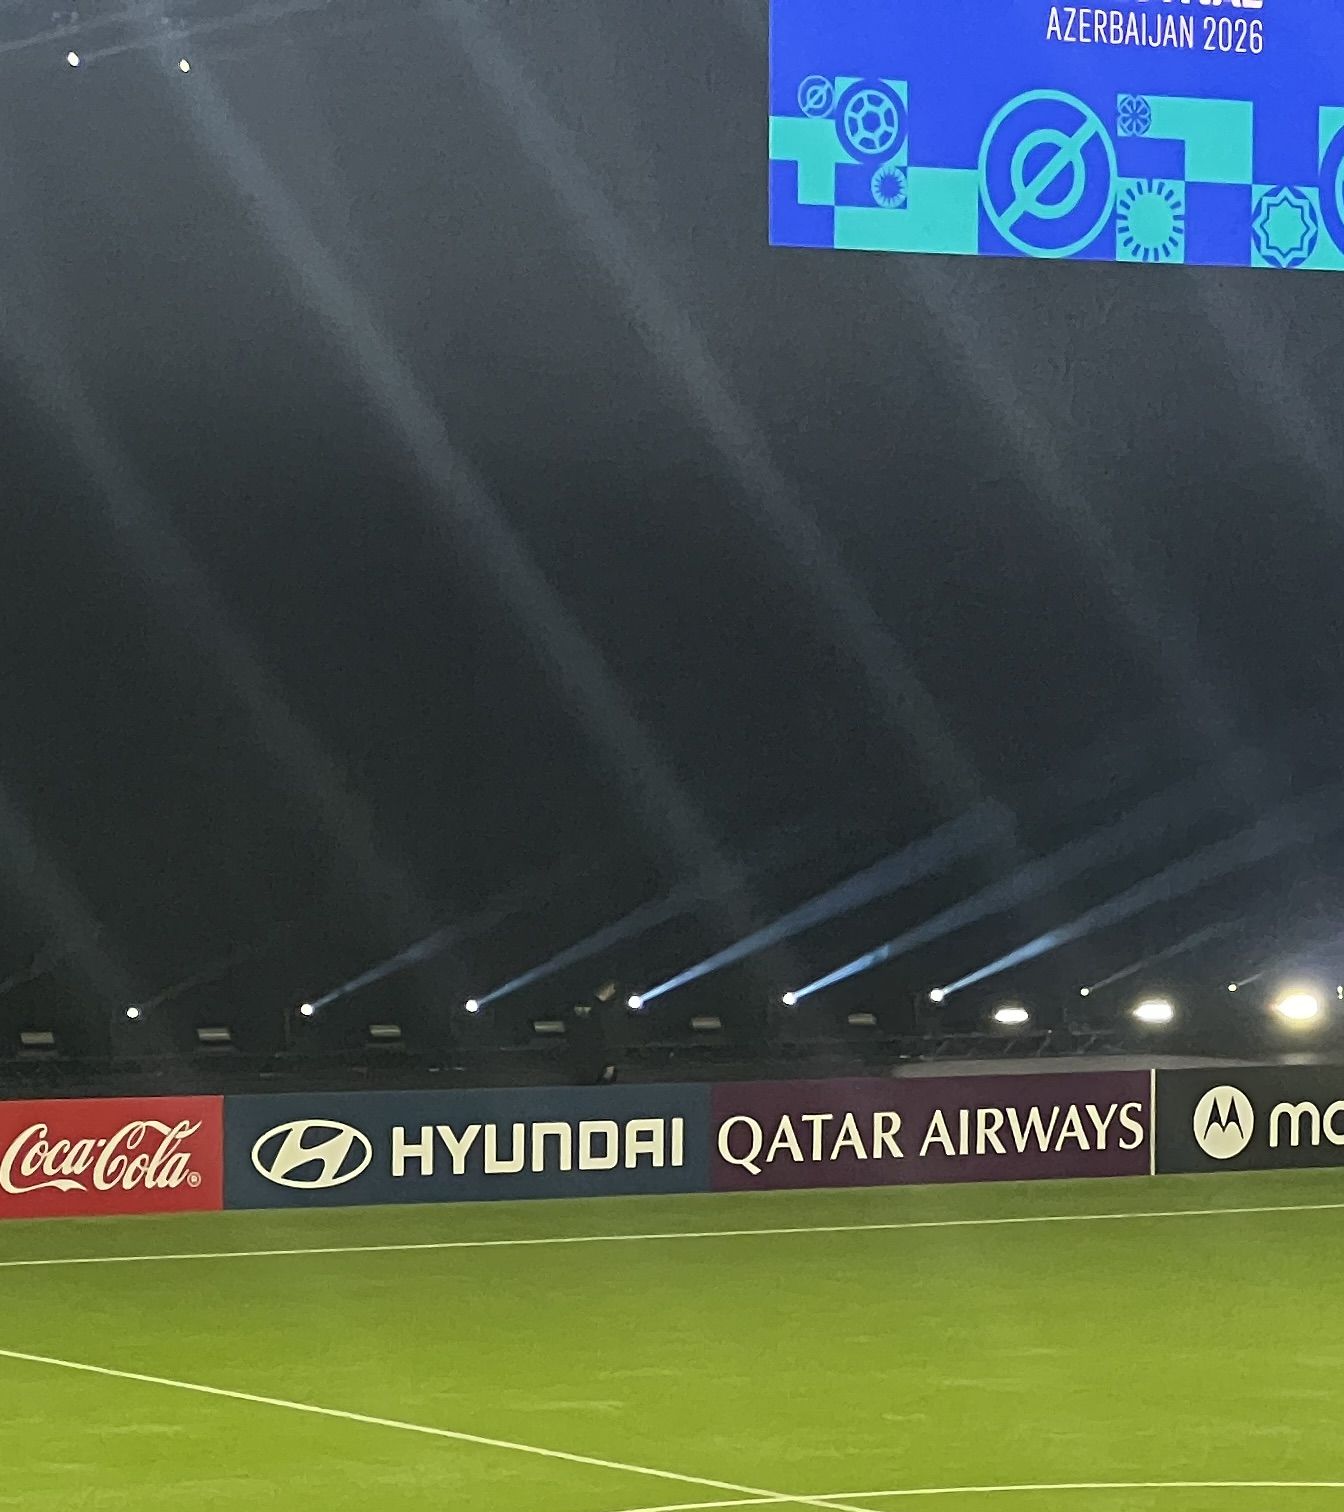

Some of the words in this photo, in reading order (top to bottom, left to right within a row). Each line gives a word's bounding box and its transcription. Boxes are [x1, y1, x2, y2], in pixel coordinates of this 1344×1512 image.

[1046, 6, 1194, 49] AZERBAIJAN
[1203, 16, 1264, 54] 2026
[392, 1117, 684, 1177] HYUNDAI
[717, 1110, 905, 1177] QATAR
[919, 1101, 1145, 1157] AIRWAYS
